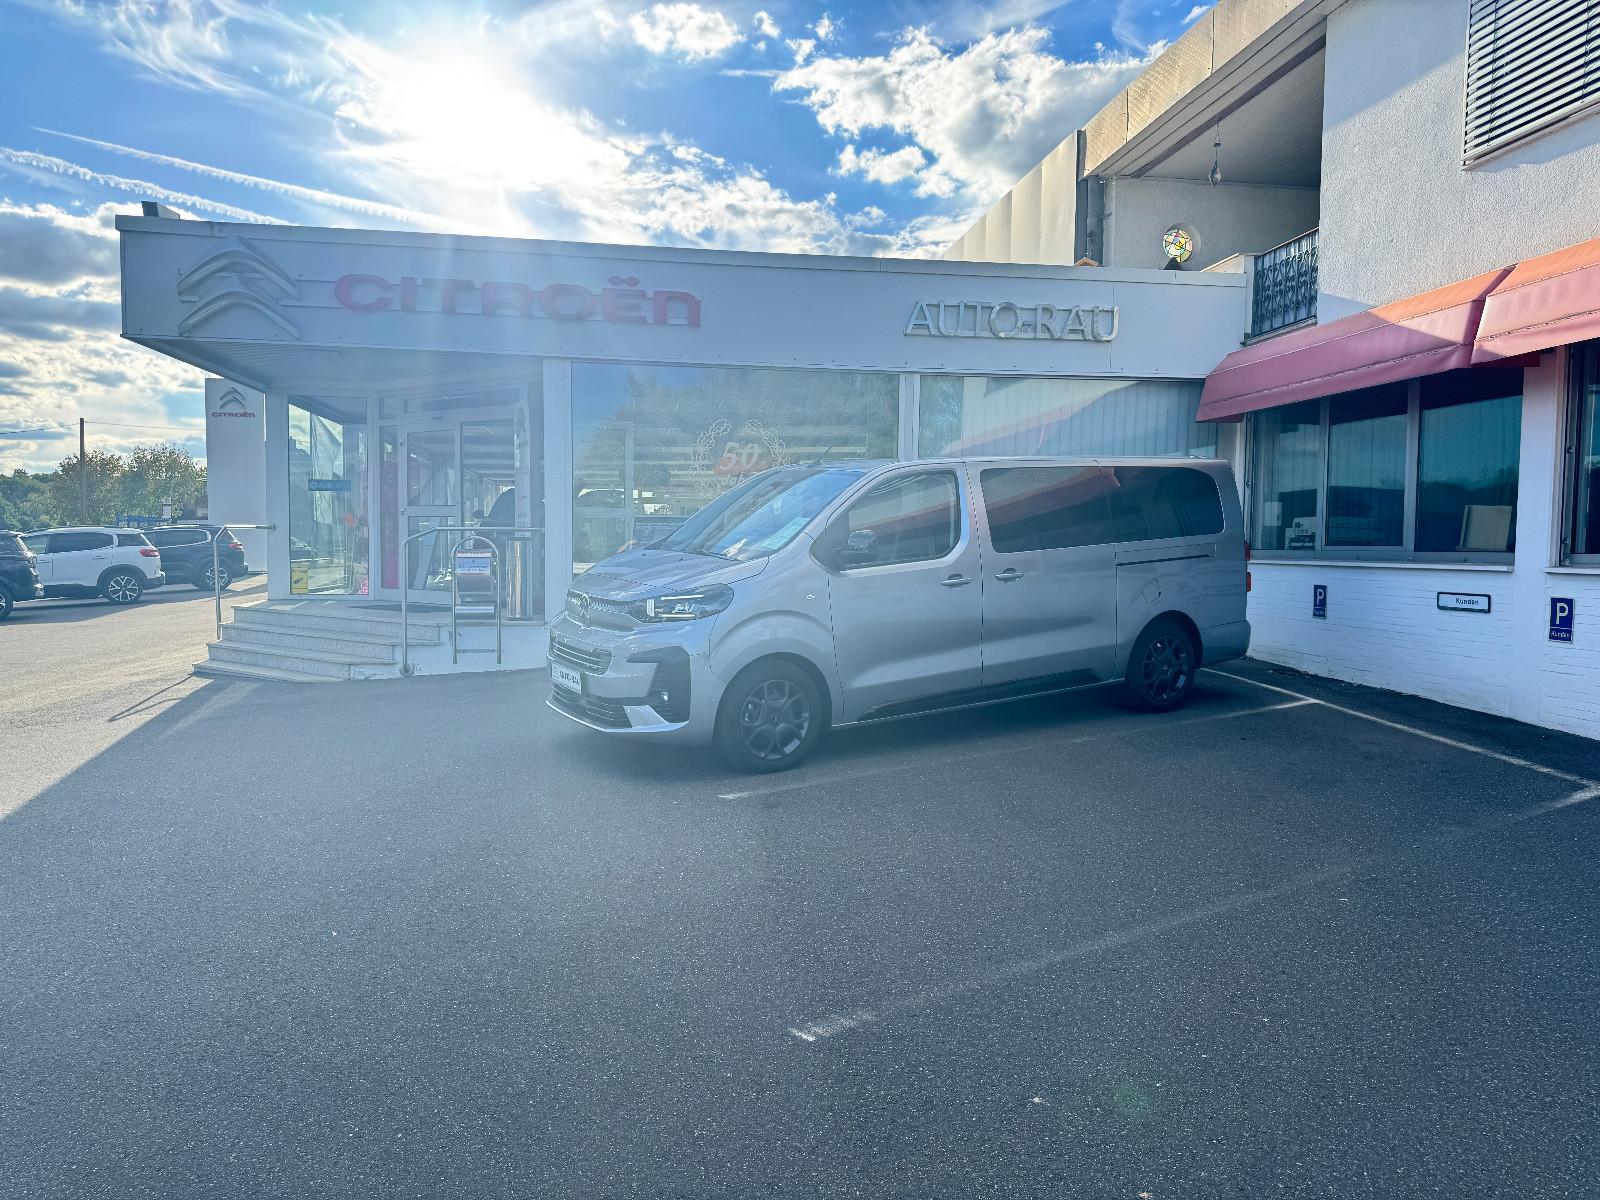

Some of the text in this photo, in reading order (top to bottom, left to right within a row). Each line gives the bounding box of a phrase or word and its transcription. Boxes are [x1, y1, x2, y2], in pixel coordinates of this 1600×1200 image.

[903, 300, 1119, 343] AUTO-RAU
[719, 441, 759, 471] 50
[1316, 588, 1325, 606] P
[1455, 597, 1479, 606] Kunden
[1555, 602, 1569, 625] P
